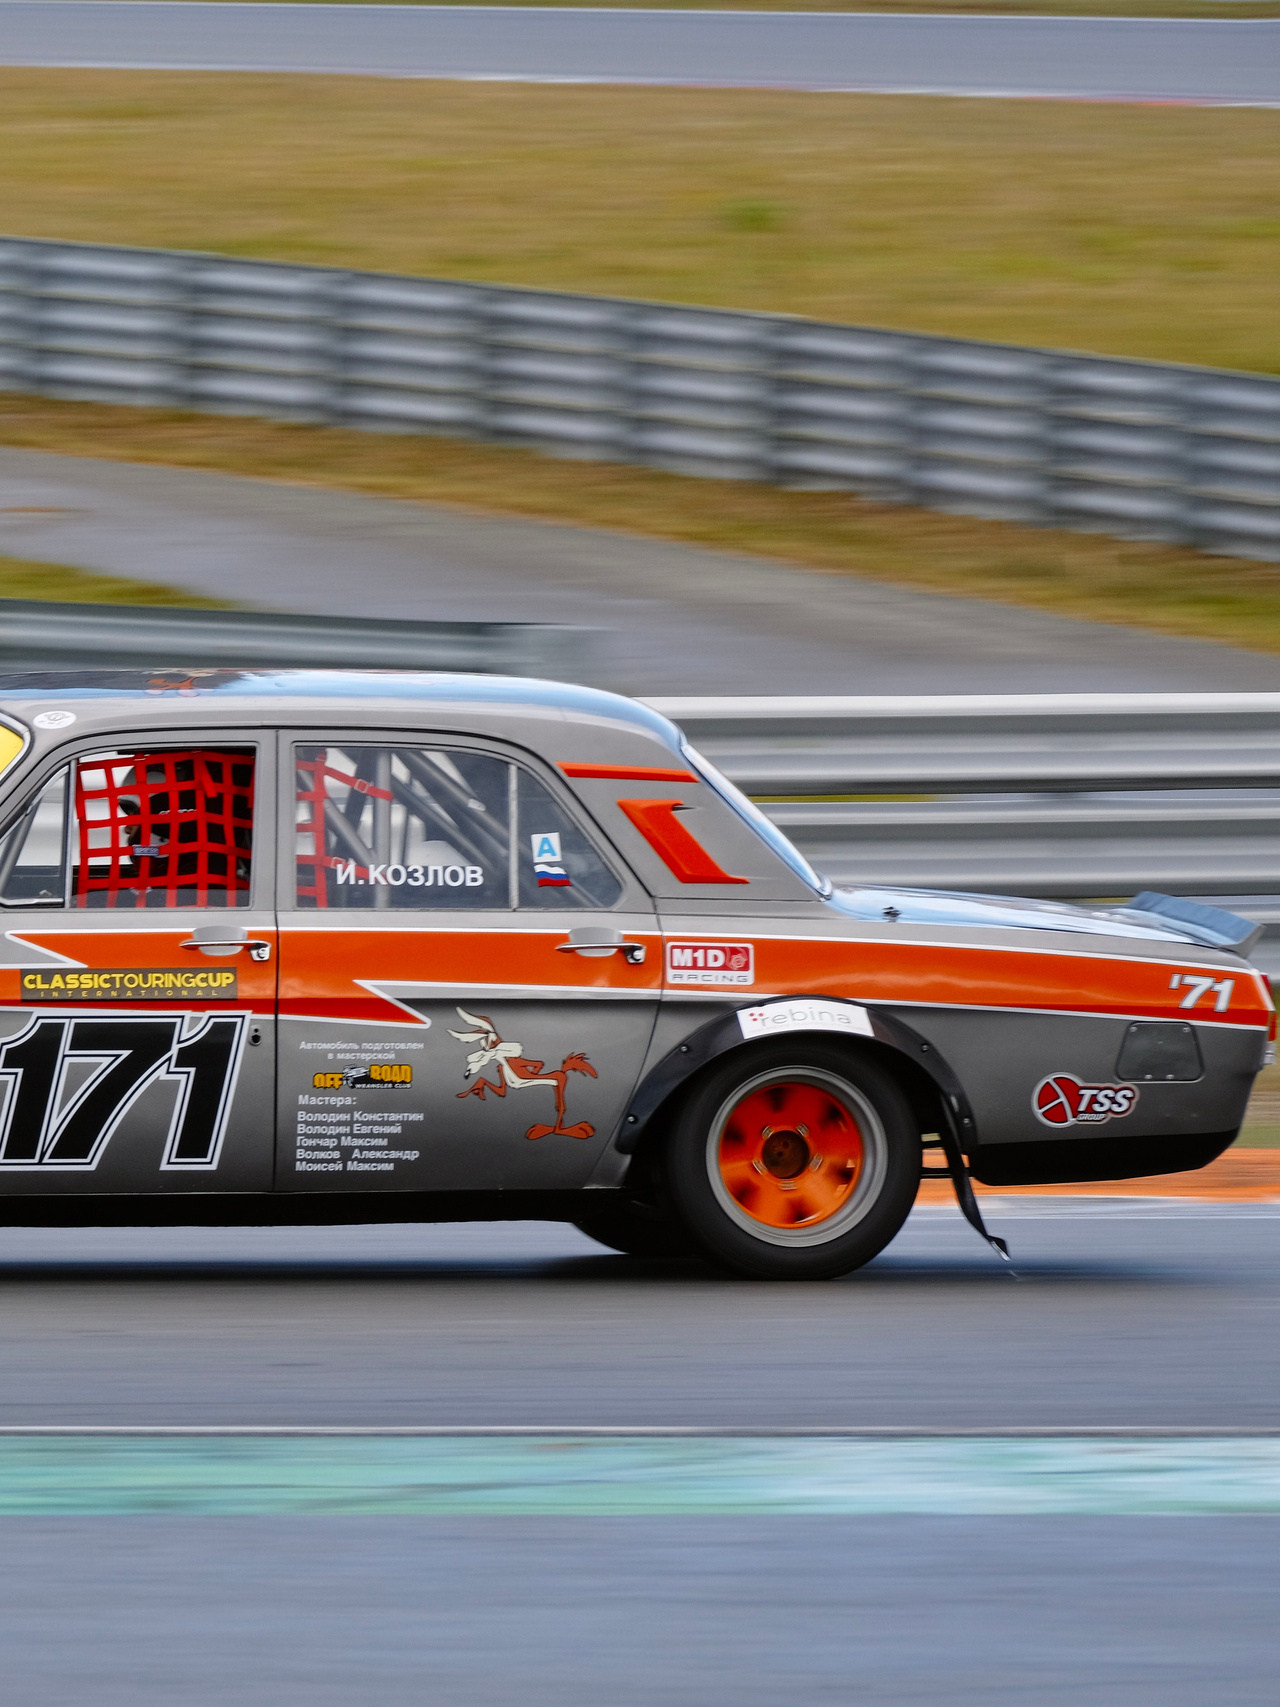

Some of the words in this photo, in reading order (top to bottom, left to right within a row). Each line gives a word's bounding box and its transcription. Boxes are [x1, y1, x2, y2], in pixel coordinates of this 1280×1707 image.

[672, 949, 725, 967] M1D
[673, 973, 749, 983] RACING
[40, 989, 219, 997] INTERNATIONAL
[1168, 973, 1235, 1013] '71
[760, 1006, 852, 1027] rebina
[299, 1041, 359, 1050] Автомобиль
[361, 1042, 425, 1051] подготовлен
[336, 1051, 396, 1062] мастерской
[313, 1073, 344, 1090] OFF
[369, 1064, 413, 1084] ROAD
[298, 1094, 357, 1107] Мастера:
[1077, 1089, 1134, 1112] TSS
[297, 1111, 351, 1122] Володин
[353, 1111, 424, 1121] Константин
[297, 1123, 350, 1135] Володин
[352, 1123, 402, 1134] Евгений
[296, 1136, 338, 1148] Гончар
[340, 1136, 388, 1146] Максим
[296, 1149, 341, 1159] Волков
[351, 1149, 420, 1161] Александр
[295, 1161, 343, 1171] Моисей
[346, 1161, 395, 1171] Максим
